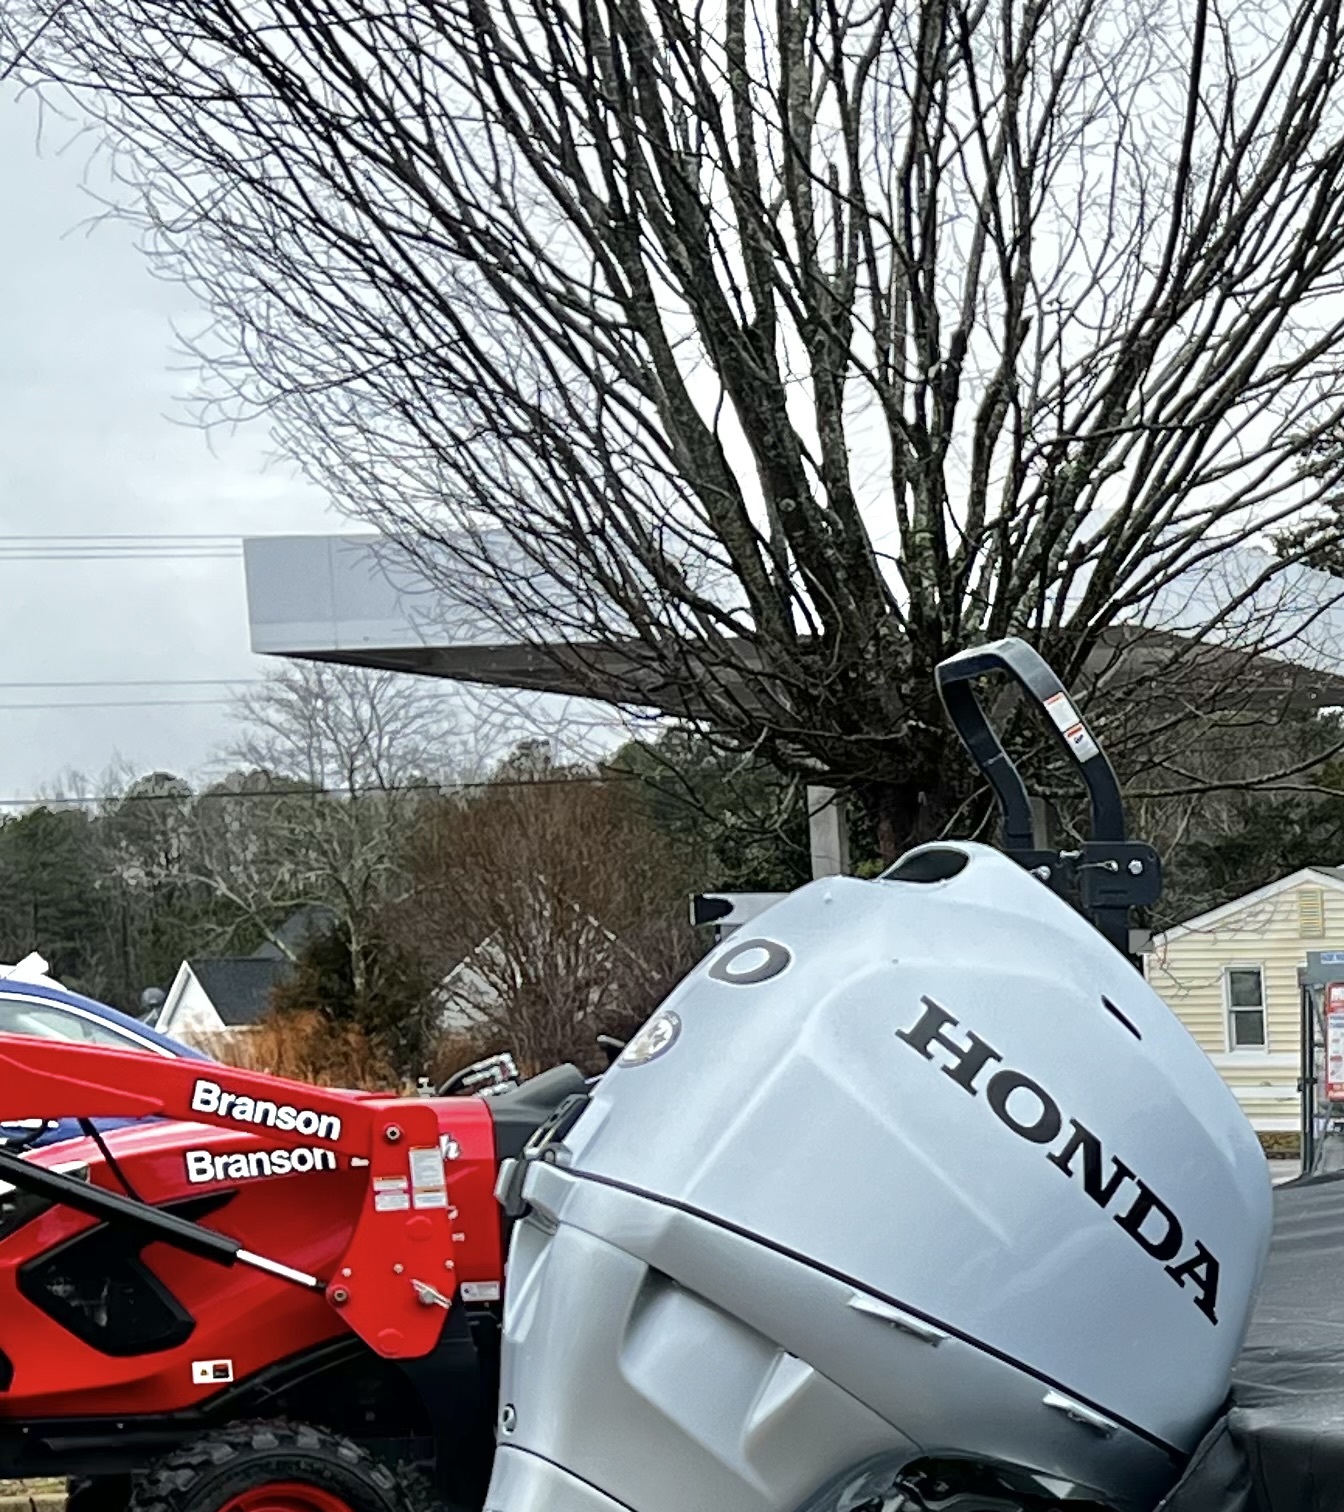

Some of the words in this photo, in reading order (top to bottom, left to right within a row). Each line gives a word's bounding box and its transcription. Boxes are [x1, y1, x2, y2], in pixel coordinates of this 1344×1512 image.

[192, 1080, 341, 1140] Branson
[186, 1147, 336, 1183] Branson
[895, 995, 1220, 1325] HONDA
